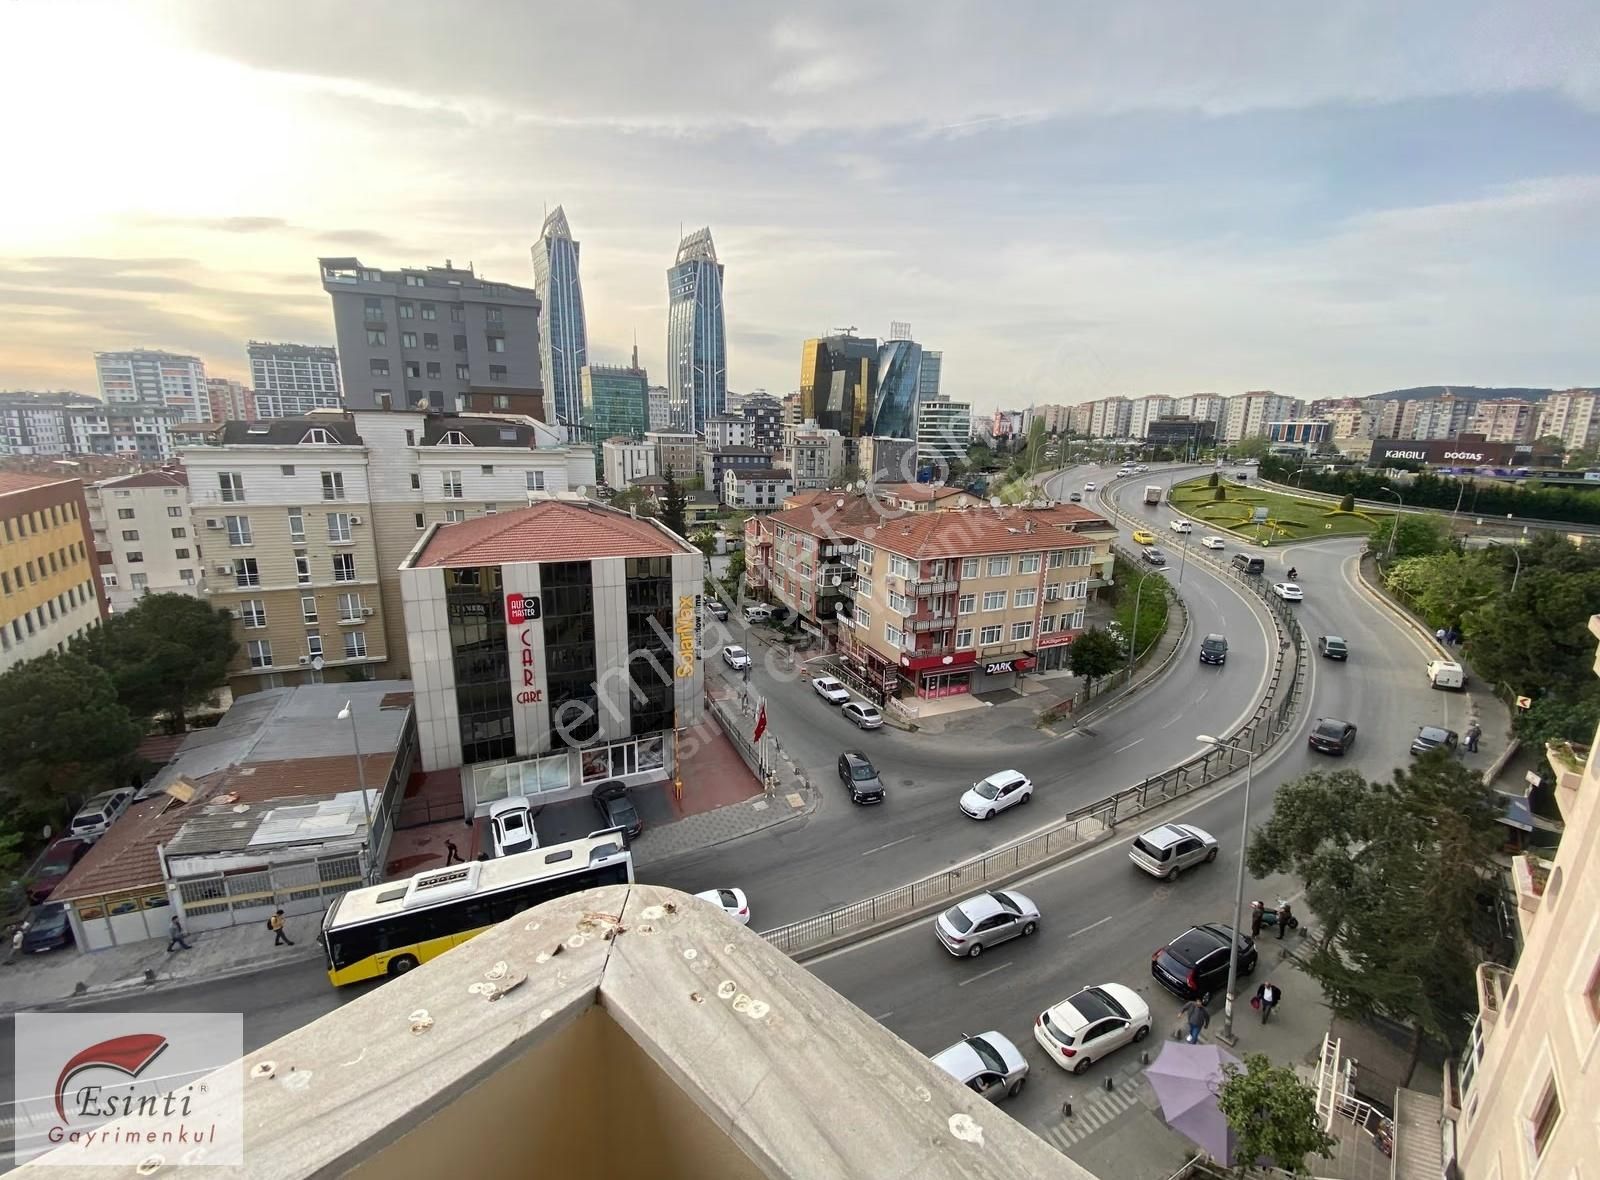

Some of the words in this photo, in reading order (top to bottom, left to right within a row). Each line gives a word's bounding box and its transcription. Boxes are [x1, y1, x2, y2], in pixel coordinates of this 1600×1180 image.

[1444, 451, 1485, 460] DOĞTAŞ
[511, 599, 535, 610] AUTO
[512, 608, 536, 618] MASTER
[676, 594, 694, 678] SolarMax
[521, 628, 534, 687] CAR
[986, 661, 1013, 673] DARK
[516, 689, 543, 704] CARE
